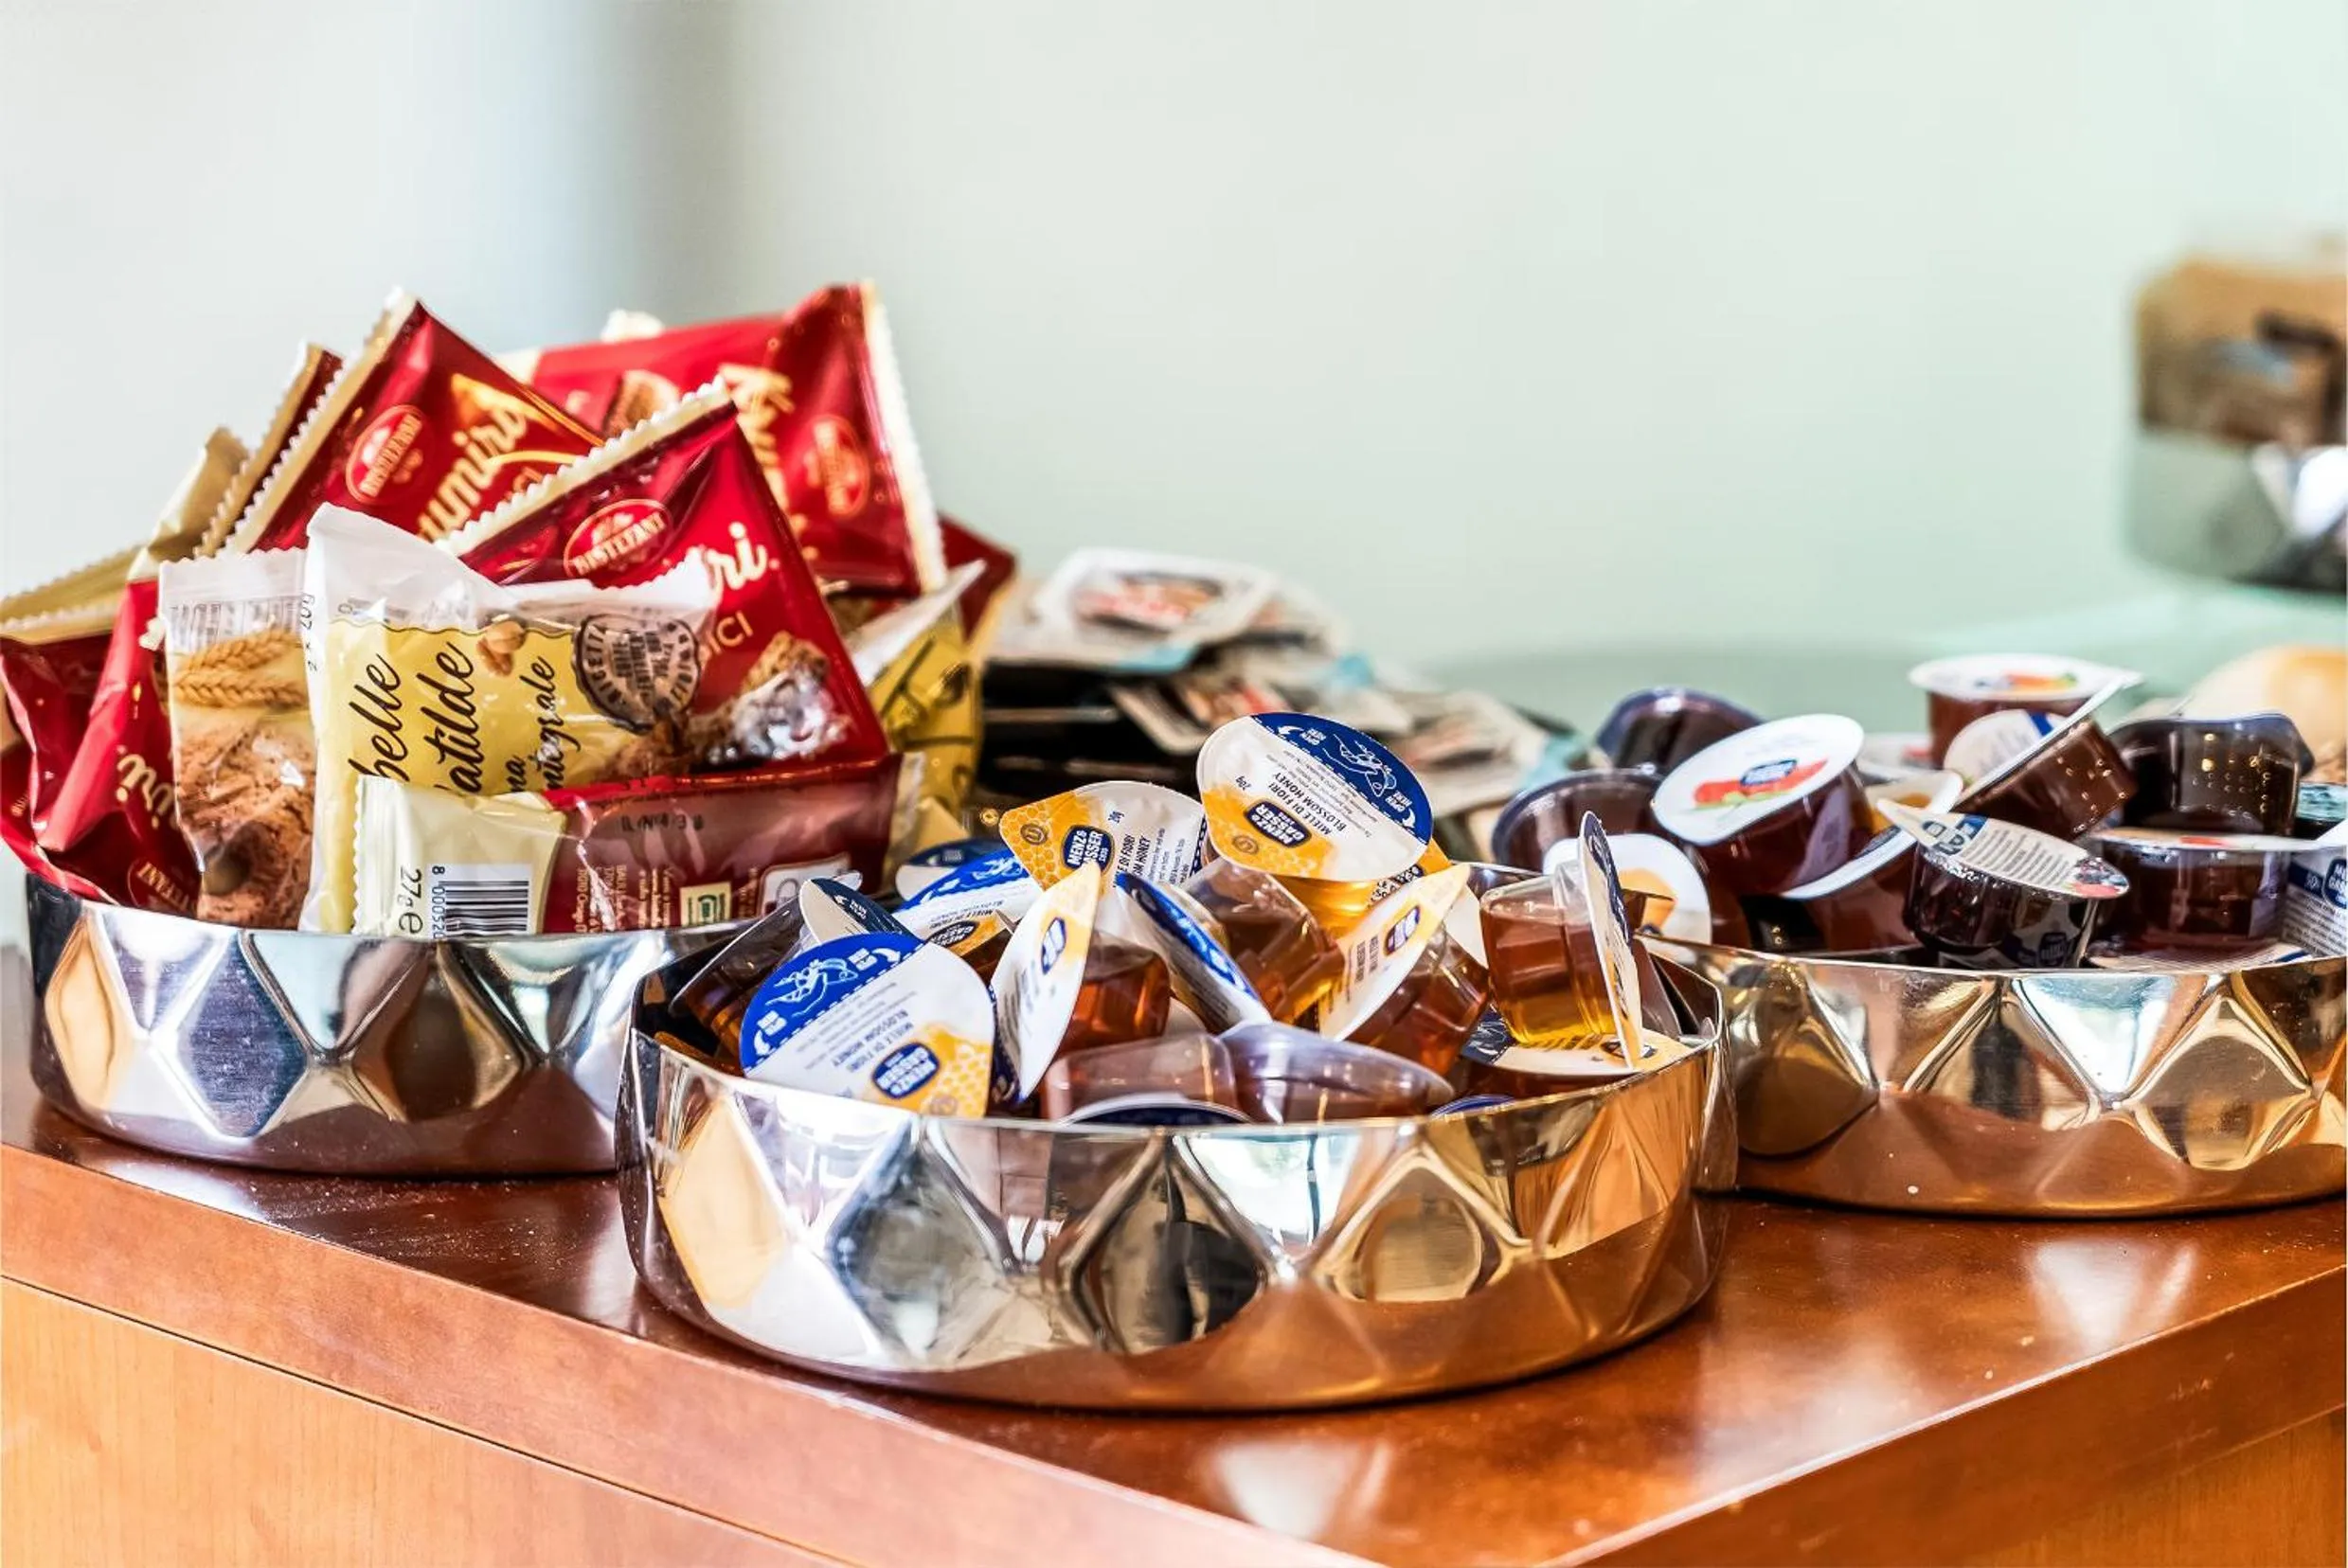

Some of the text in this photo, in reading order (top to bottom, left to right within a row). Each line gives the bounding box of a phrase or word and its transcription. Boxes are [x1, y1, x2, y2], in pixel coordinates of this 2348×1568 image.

[417, 642, 485, 795] atilde
[519, 656, 581, 791] ntegrale
[1268, 782, 1295, 804] FIORI
[1272, 771, 1306, 799] HONEY
[1257, 803, 1305, 841] GASSER
[1293, 803, 1304, 814] DI
[1303, 796, 1347, 832] BLOSSOM
[1304, 812, 1333, 835] MIELE
[1083, 830, 1103, 866] ASSER
